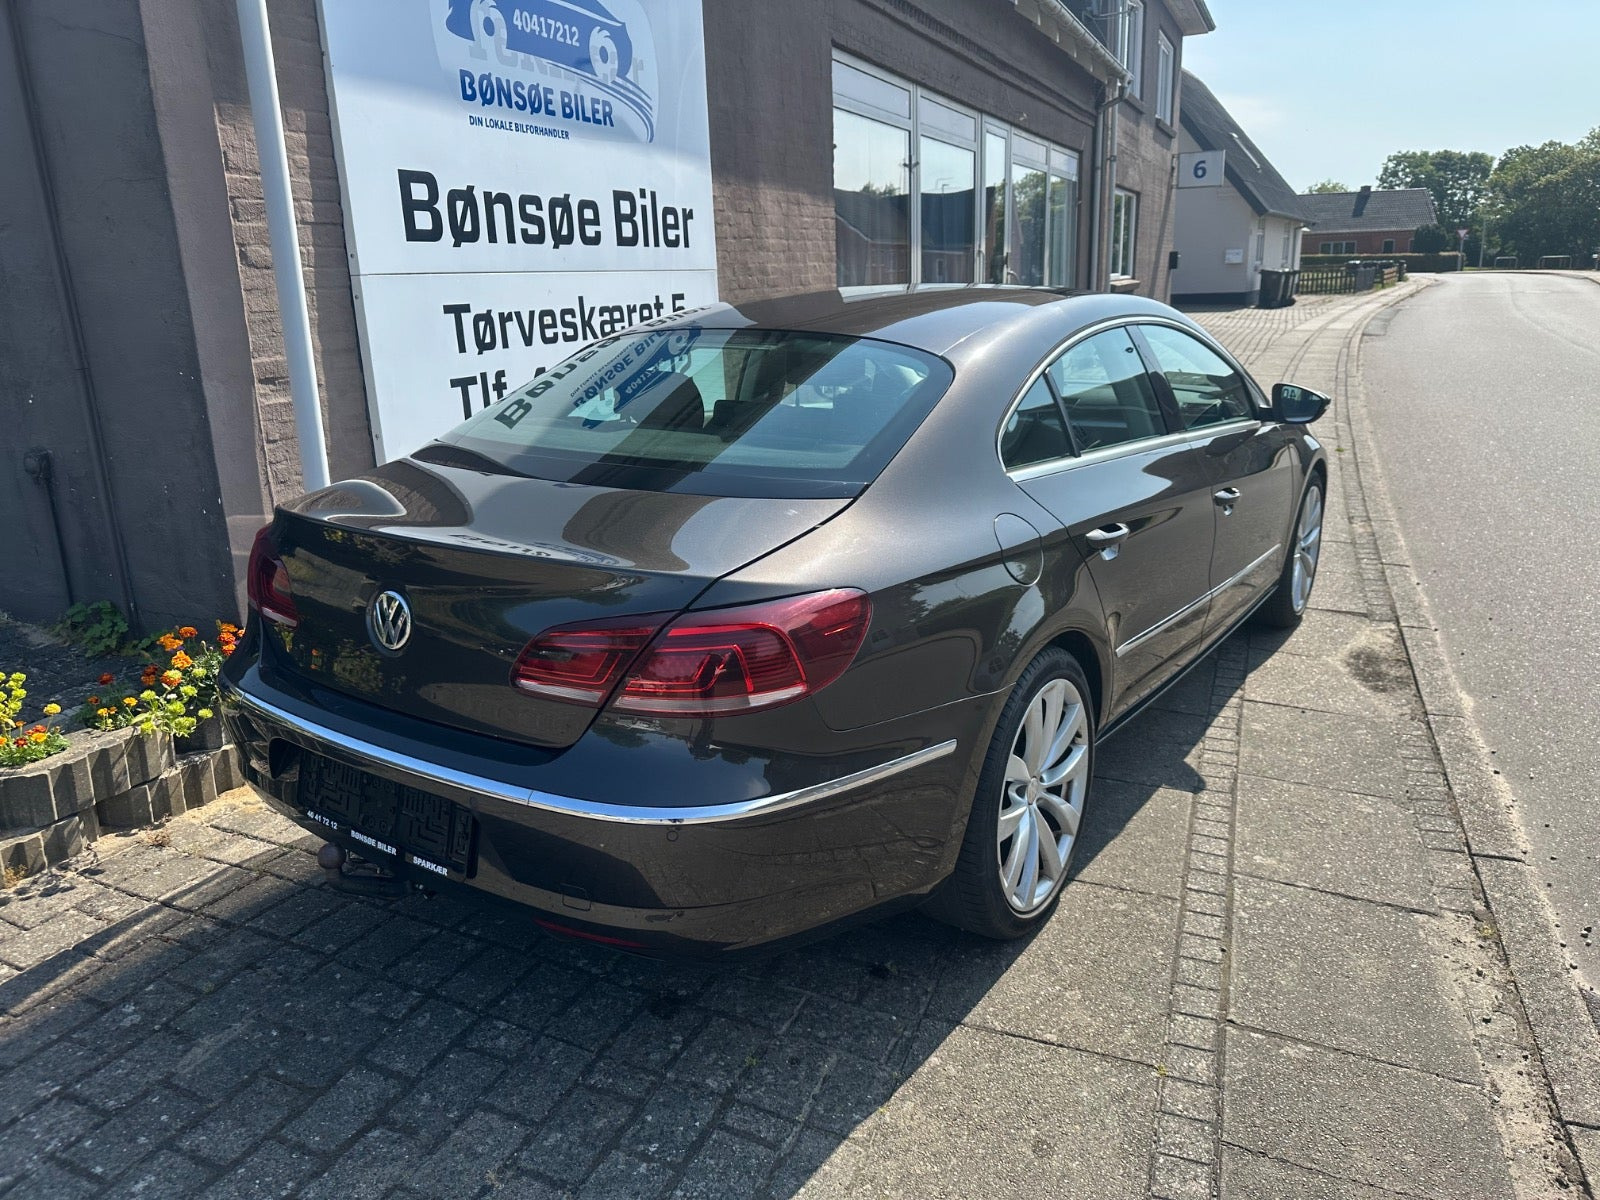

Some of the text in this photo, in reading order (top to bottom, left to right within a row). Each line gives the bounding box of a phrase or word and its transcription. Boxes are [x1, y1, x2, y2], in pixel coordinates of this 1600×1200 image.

[513, 8, 580, 47] 40417212
[459, 69, 615, 127] BØNSØE BILER
[469, 115, 570, 140] DIN LOKALE BILFORHANDLER
[1193, 160, 1207, 179] 6
[398, 168, 693, 249] Bønsøe Biler
[443, 295, 664, 355] Tørveskæret
[315, 814, 321, 822] 41
[323, 817, 330, 826] 72
[331, 821, 338, 830] 12
[377, 841, 396, 856] BILER
[413, 856, 448, 876] SPARKÆR
